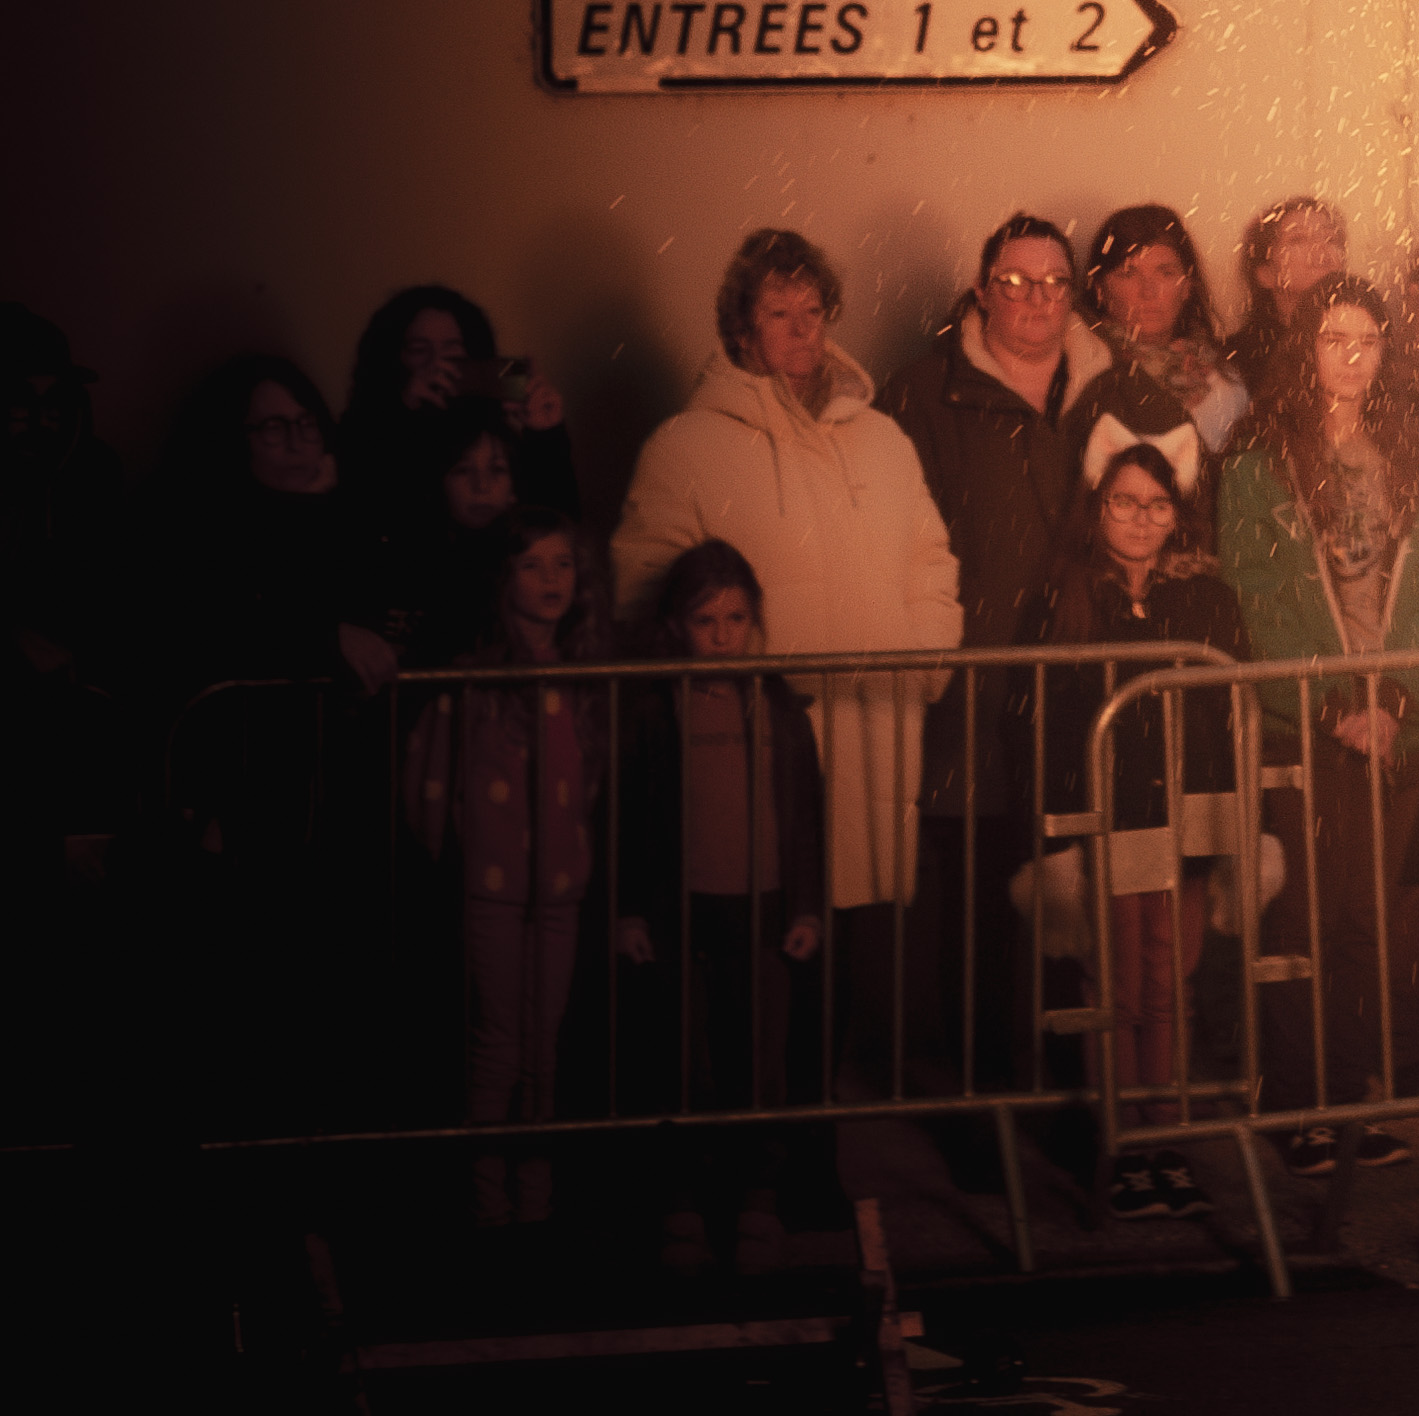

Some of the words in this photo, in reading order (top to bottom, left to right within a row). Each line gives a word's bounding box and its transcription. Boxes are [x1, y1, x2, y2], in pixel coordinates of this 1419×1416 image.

[915, 2, 932, 53] 1
[972, 8, 1027, 52] et
[1070, 1, 1105, 52] 2
